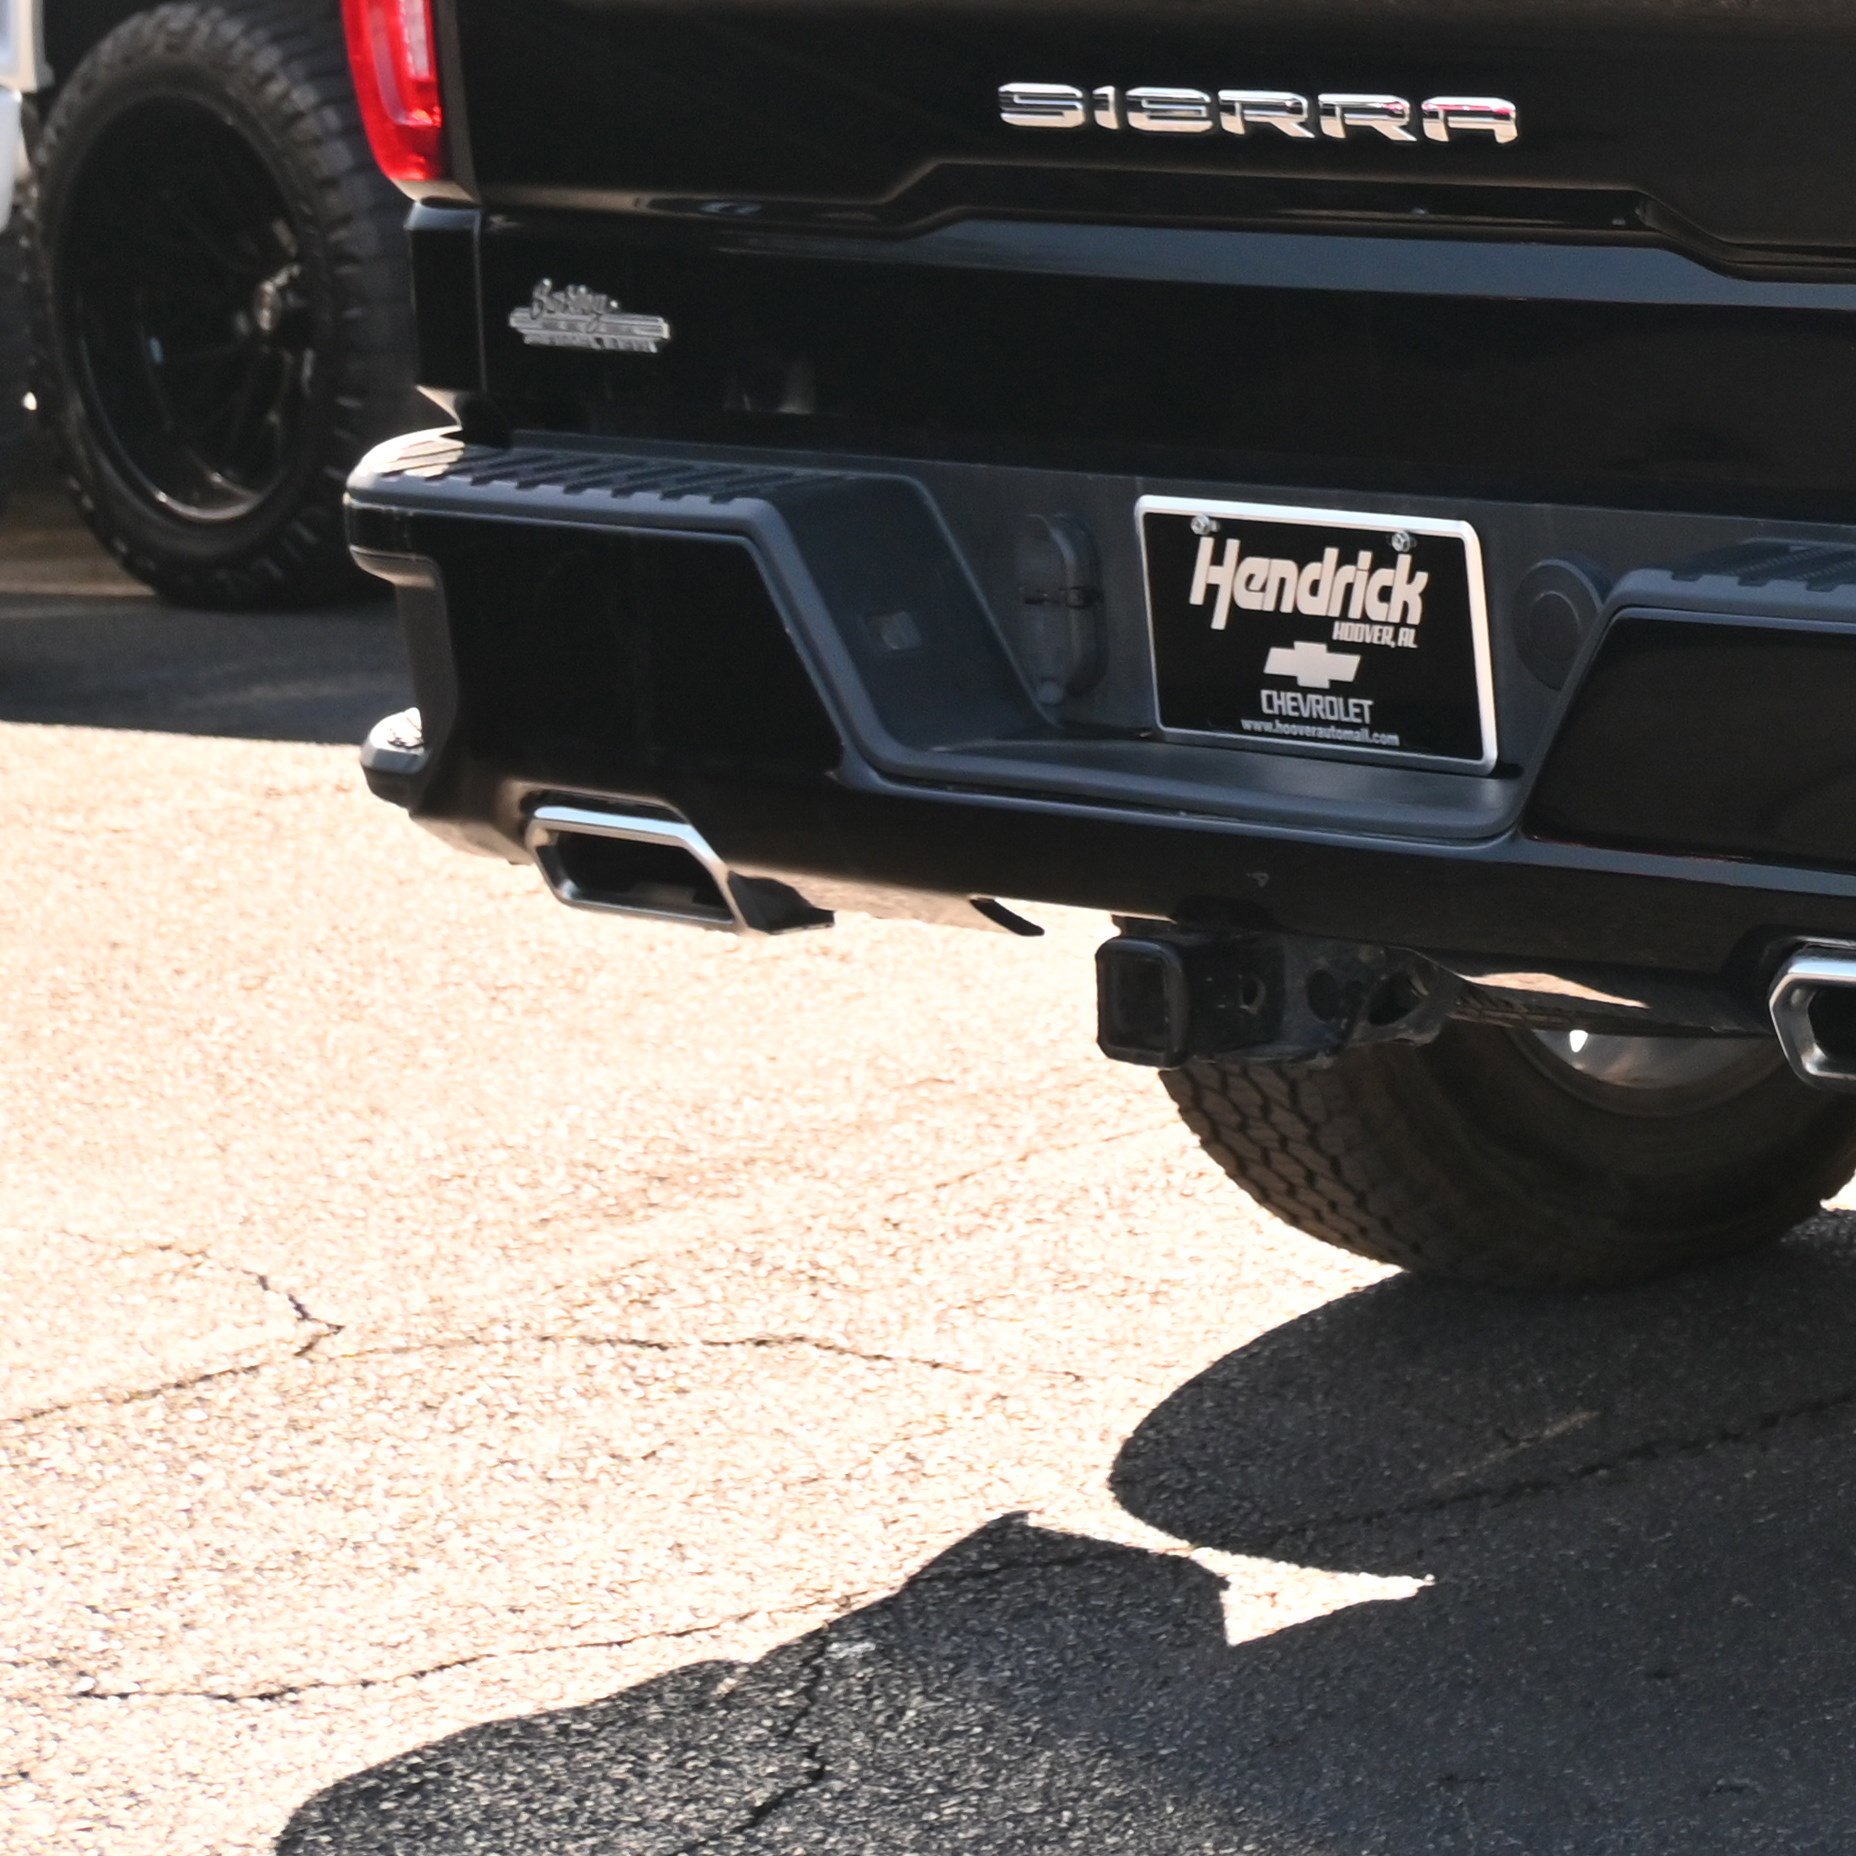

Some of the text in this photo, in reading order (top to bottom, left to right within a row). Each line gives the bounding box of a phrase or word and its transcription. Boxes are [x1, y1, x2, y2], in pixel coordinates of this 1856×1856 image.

[997, 82, 1519, 144] SIERRA
[1189, 535, 1430, 631] Hendrick
[1332, 620, 1419, 648] HOOVER, AL
[1260, 689, 1374, 725] CHEVROLET
